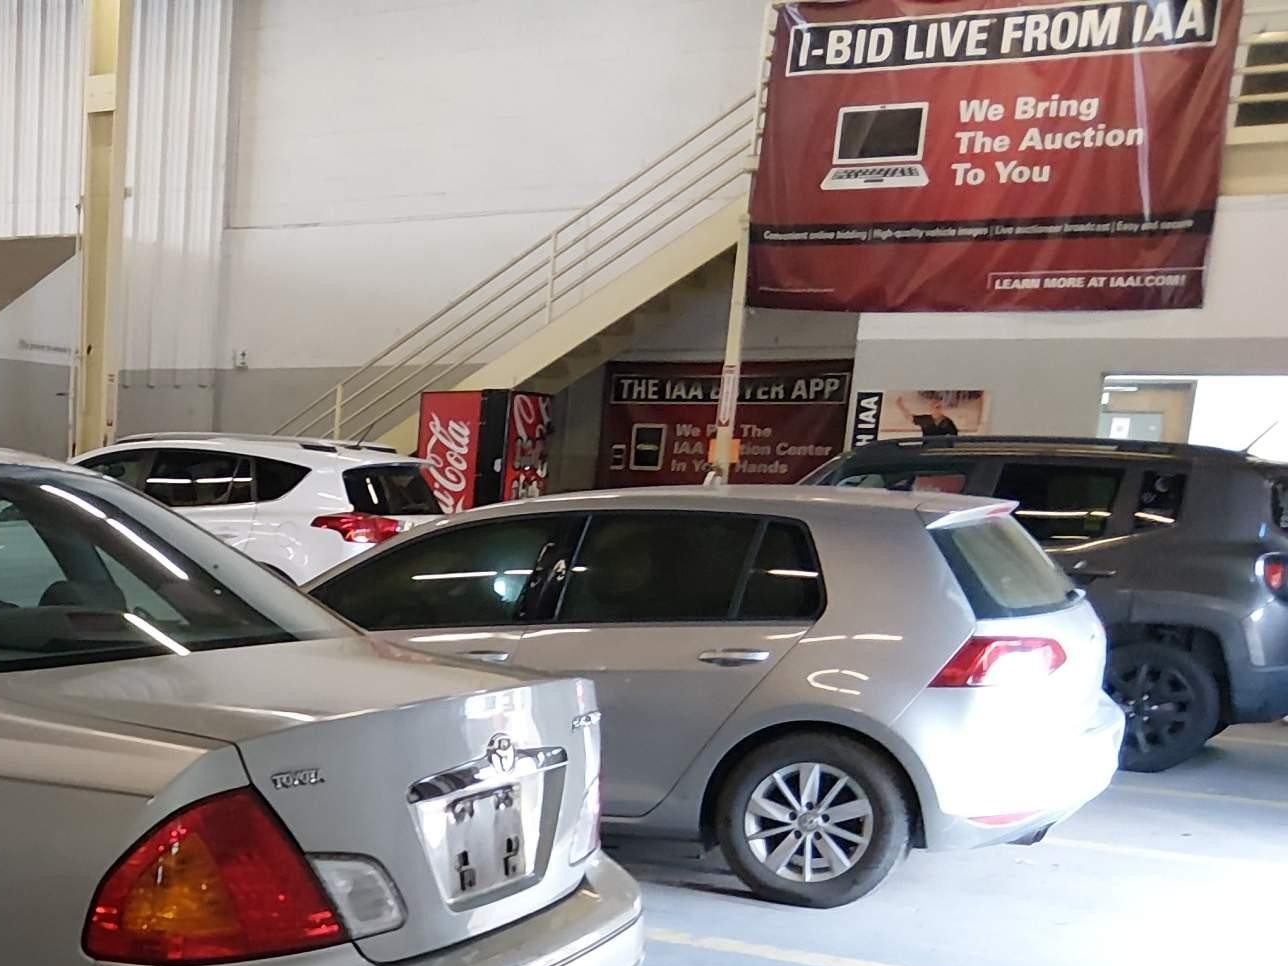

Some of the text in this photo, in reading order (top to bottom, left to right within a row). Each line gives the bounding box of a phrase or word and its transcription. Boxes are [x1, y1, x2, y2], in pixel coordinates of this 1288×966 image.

[798, 0, 1206, 68] I-BID LIVE FROM IAA
[959, 94, 1100, 123] We Bring
[955, 124, 1144, 154] The Auction
[951, 160, 1051, 186] To You
[994, 278, 1040, 290] LEARN
[1043, 276, 1084, 289] MORE
[1087, 276, 1107, 288] AT
[620, 378, 659, 400] THE
[665, 380, 703, 400] IAA
[791, 377, 840, 400] APP
[858, 395, 880, 429] IAA
[675, 423, 701, 437] We
[740, 423, 772, 438] The
[673, 441, 705, 455] IAA
[775, 441, 833, 457] Center
[670, 458, 686, 472] In
[734, 459, 789, 474] Hands
